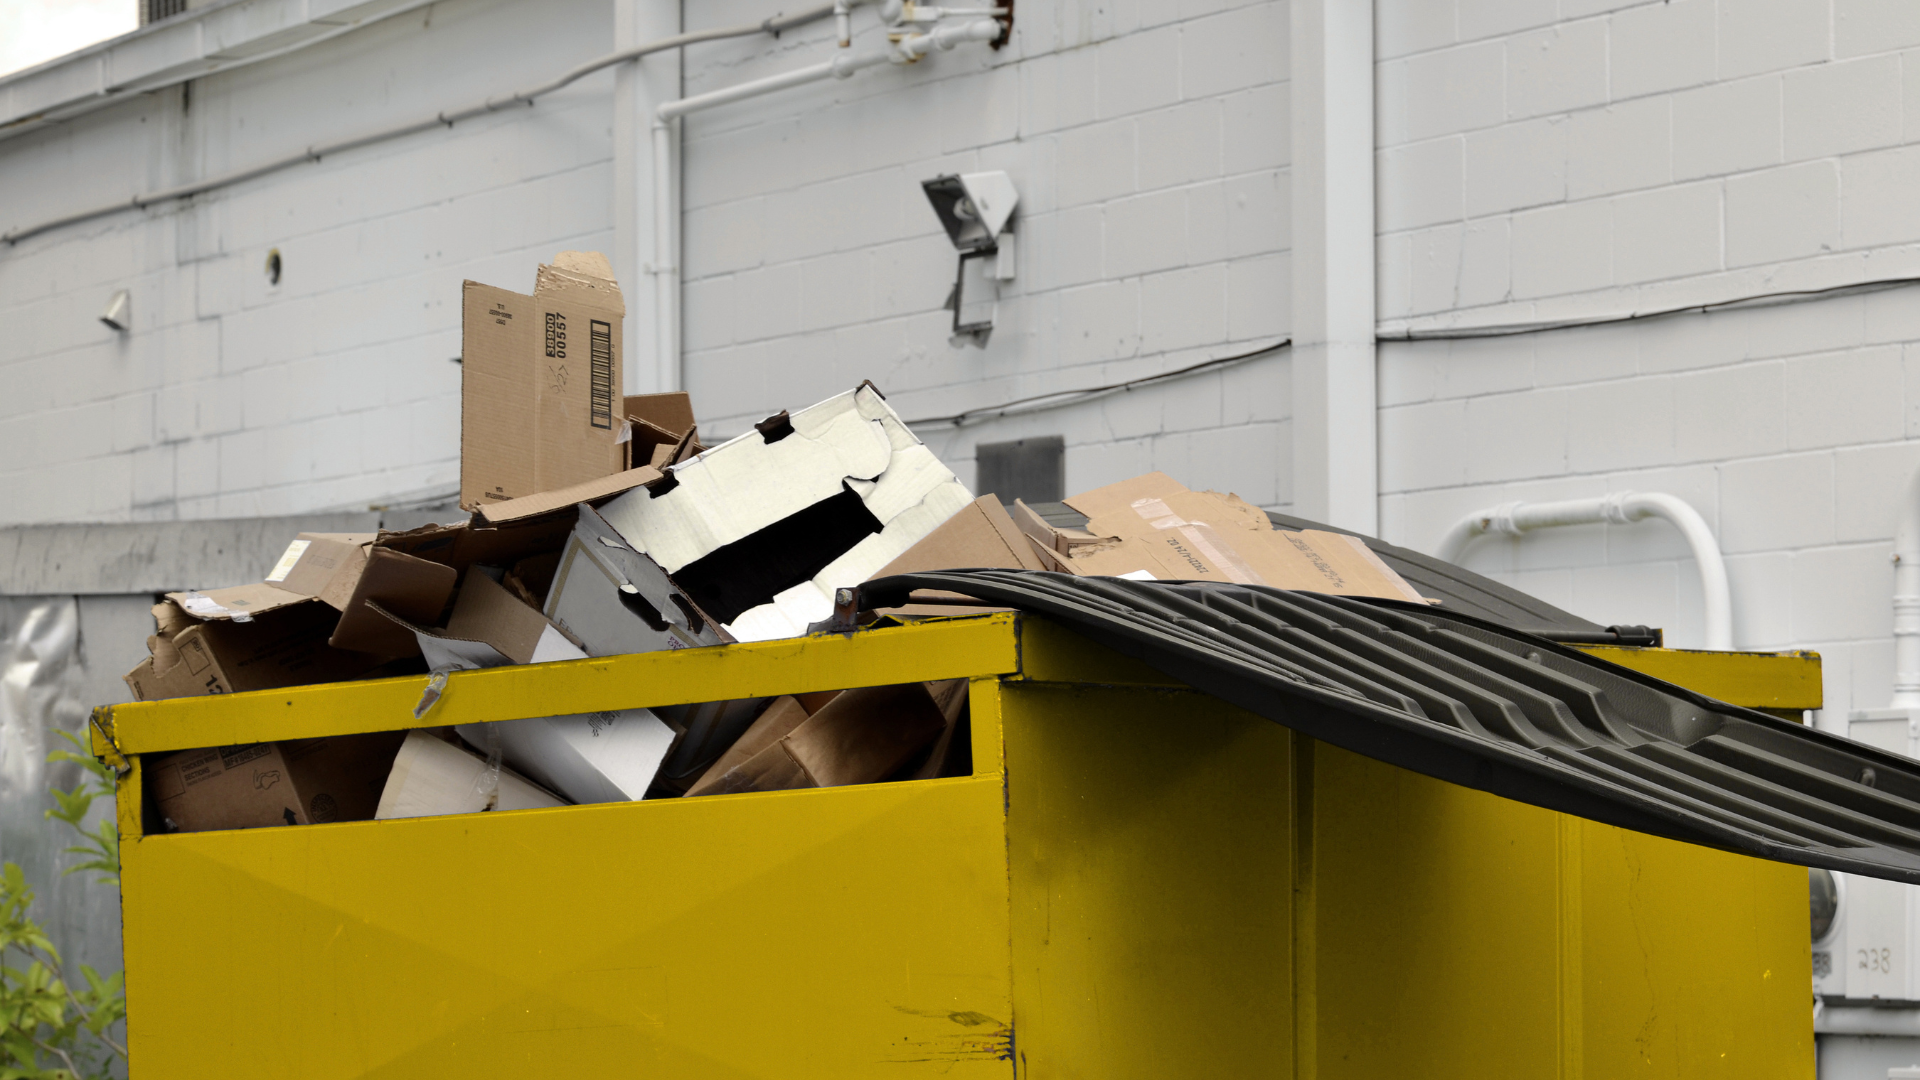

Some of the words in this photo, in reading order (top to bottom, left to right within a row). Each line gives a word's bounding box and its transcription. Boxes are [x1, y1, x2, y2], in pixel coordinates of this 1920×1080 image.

[546, 314, 556, 357] 38900
[556, 312, 567, 359] 00557
[184, 766, 211, 782] SECTIONS
[1857, 948, 1891, 974] 238
